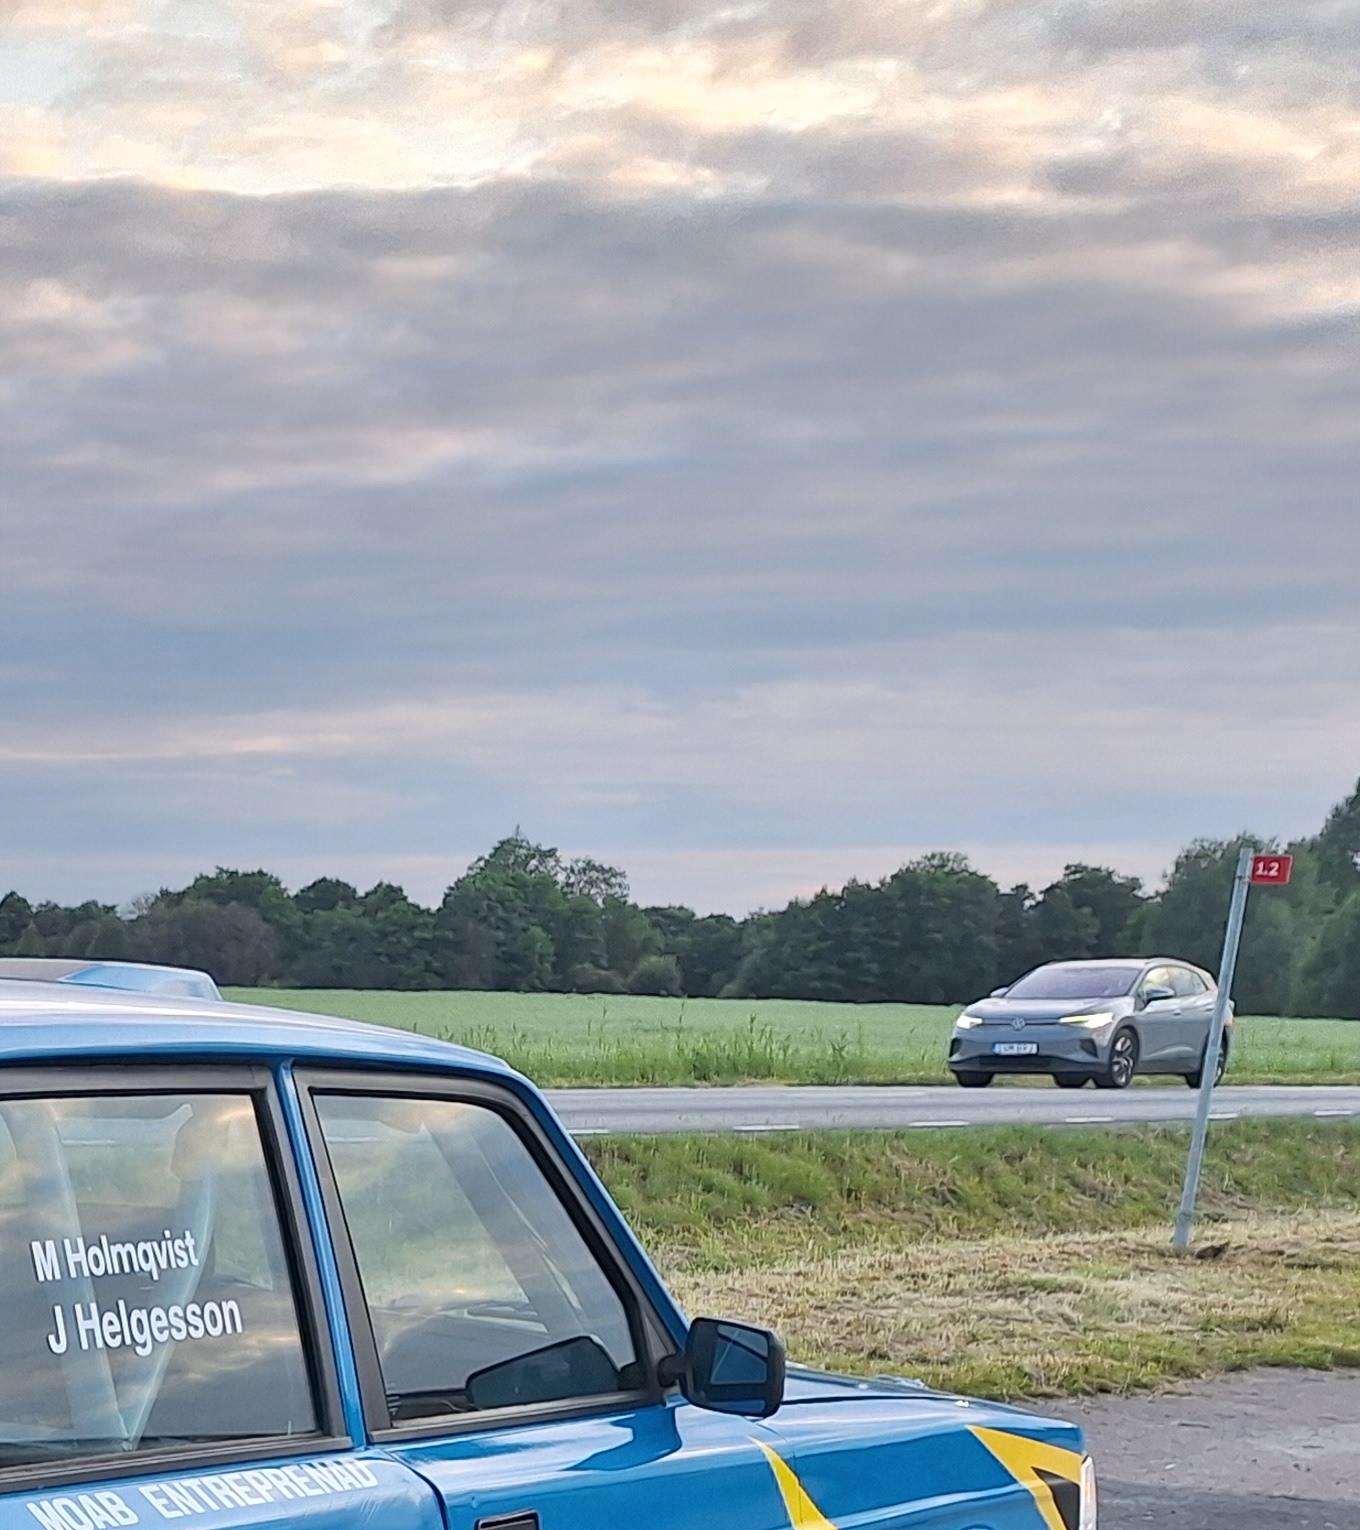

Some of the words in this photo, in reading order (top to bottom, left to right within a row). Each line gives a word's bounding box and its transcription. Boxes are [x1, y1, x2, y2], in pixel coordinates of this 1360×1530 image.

[1255, 861, 1280, 877] 1.2
[31, 1239, 60, 1283] M
[66, 1230, 199, 1281] Holmqvist
[47, 1305, 68, 1355] J
[74, 1299, 243, 1356] Helgesson
[143, 1459, 379, 1518] ENTREPRENAD
